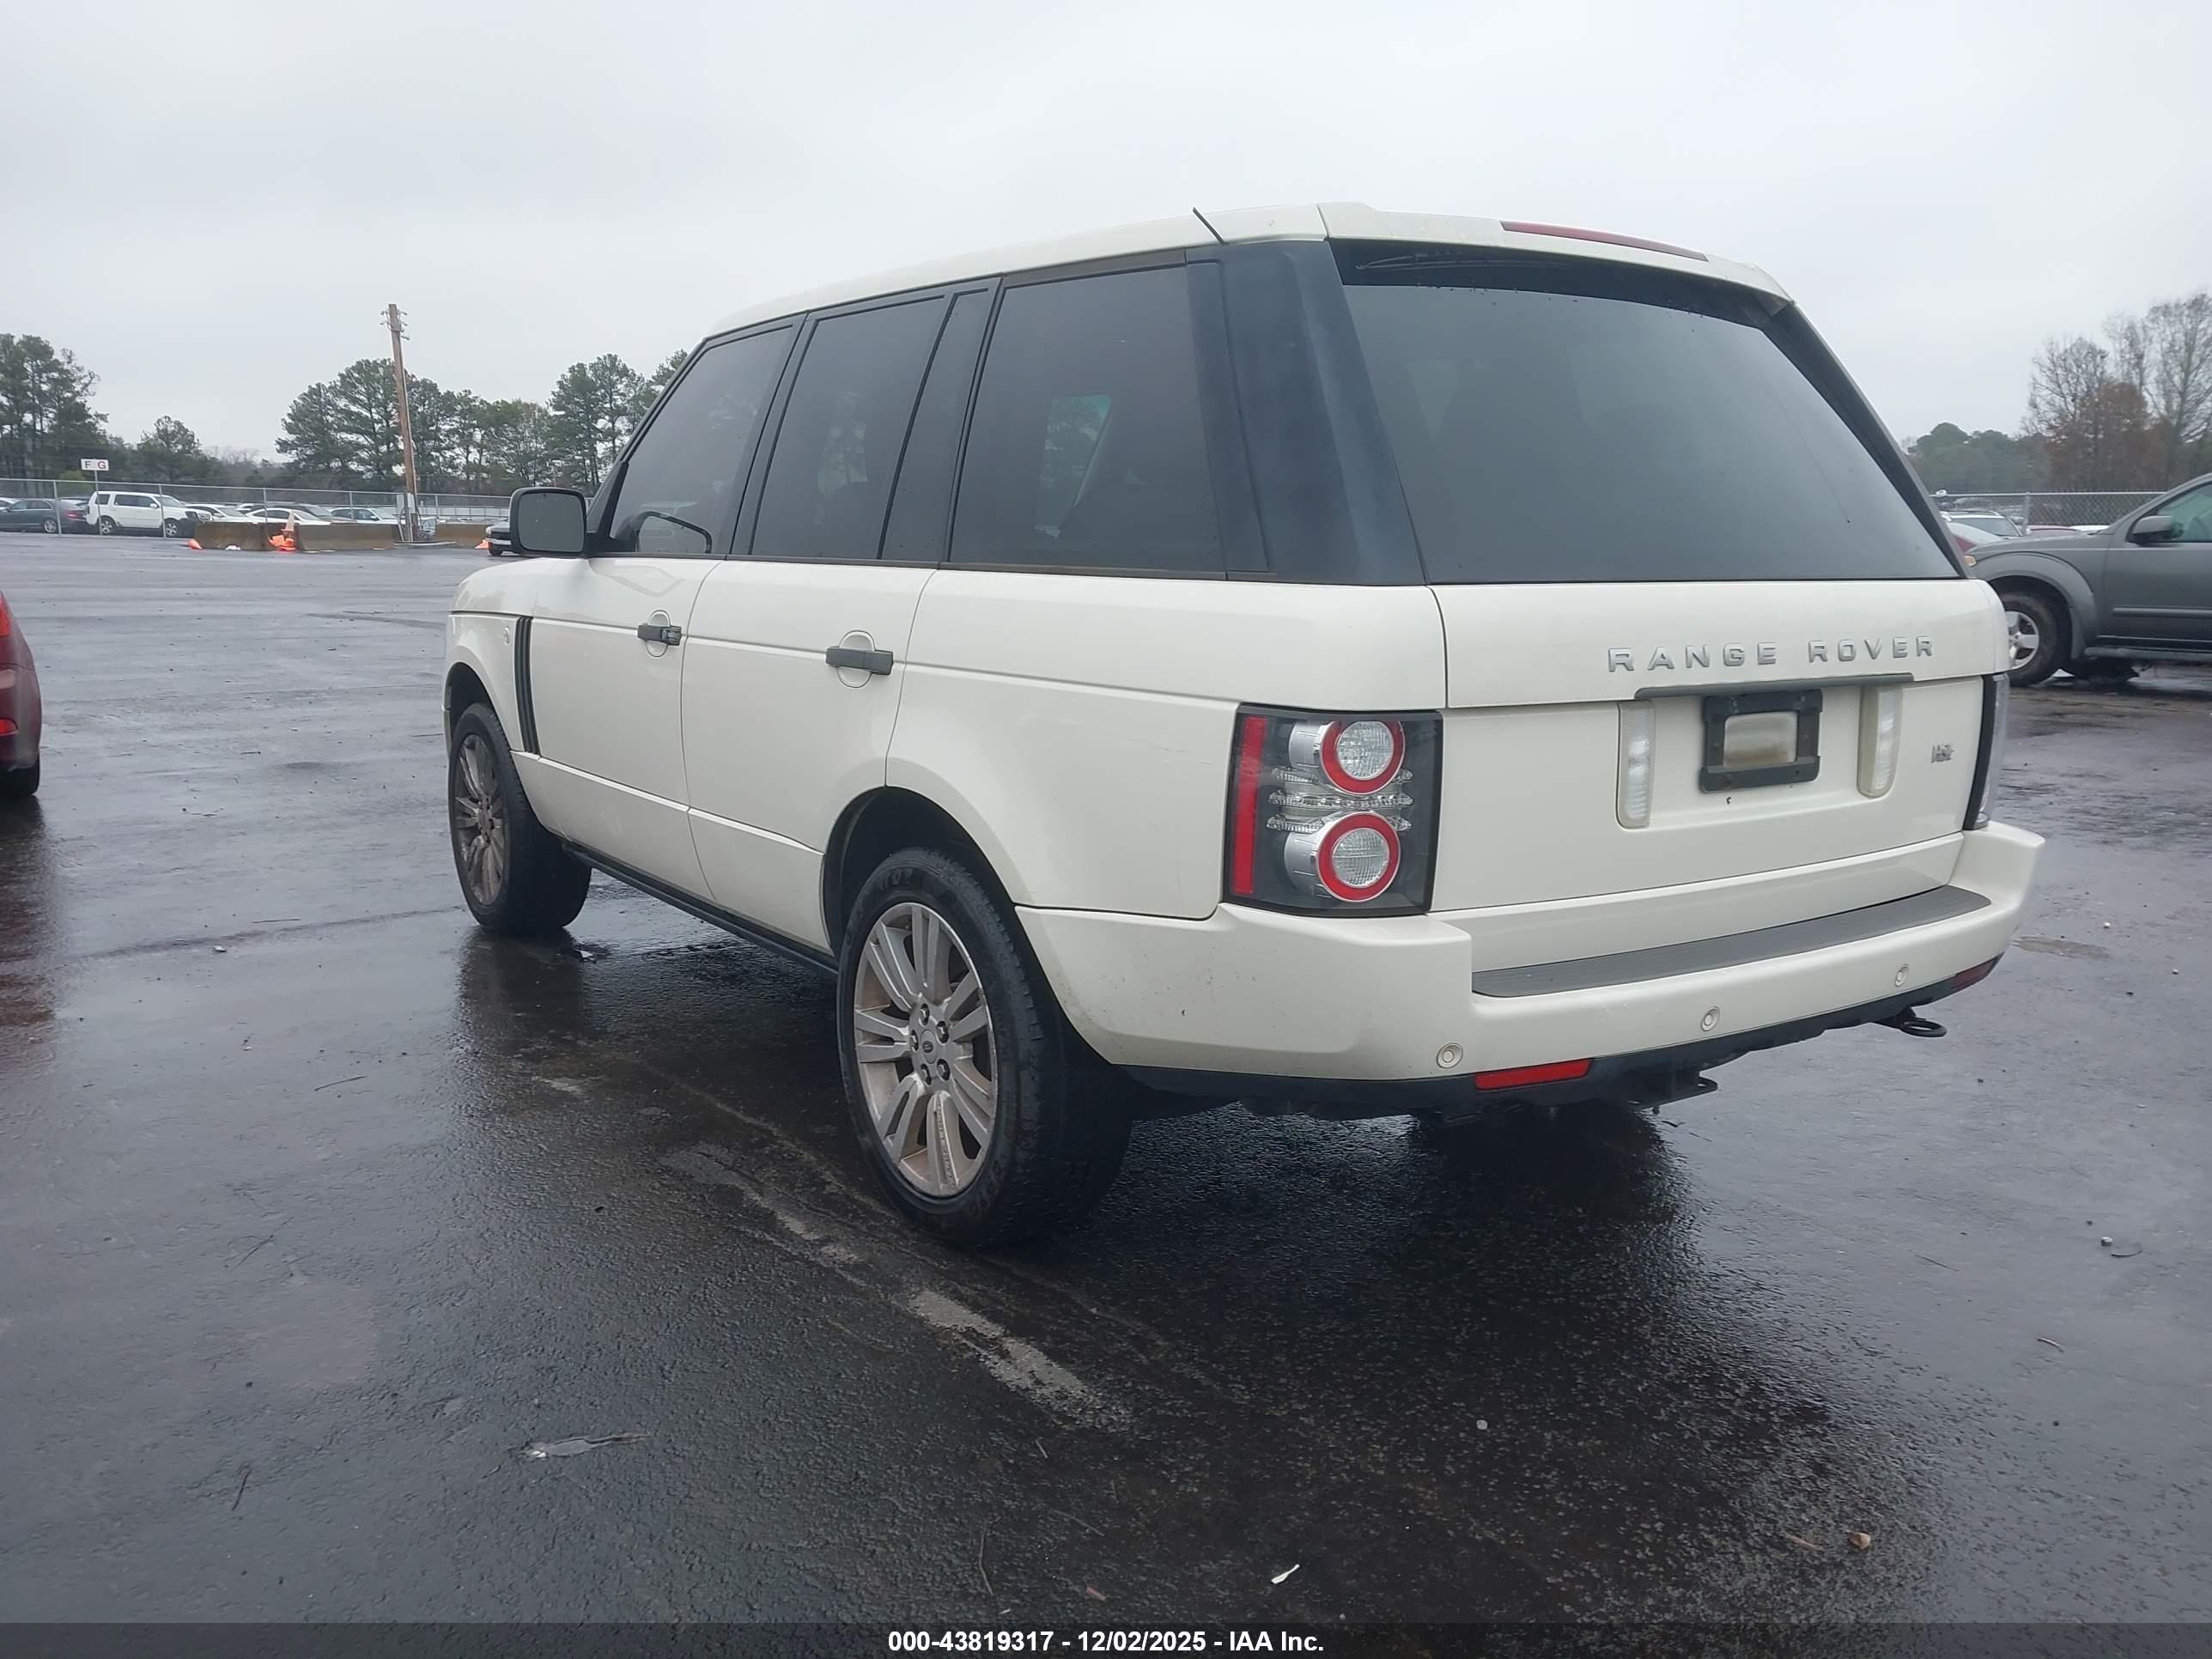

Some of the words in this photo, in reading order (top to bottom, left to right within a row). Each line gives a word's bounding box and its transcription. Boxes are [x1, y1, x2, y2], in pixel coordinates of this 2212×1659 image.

[84, 460, 91, 469] F
[97, 460, 106, 470] G
[1607, 642, 1778, 672] RANGE
[1808, 635, 1934, 663] ROVER
